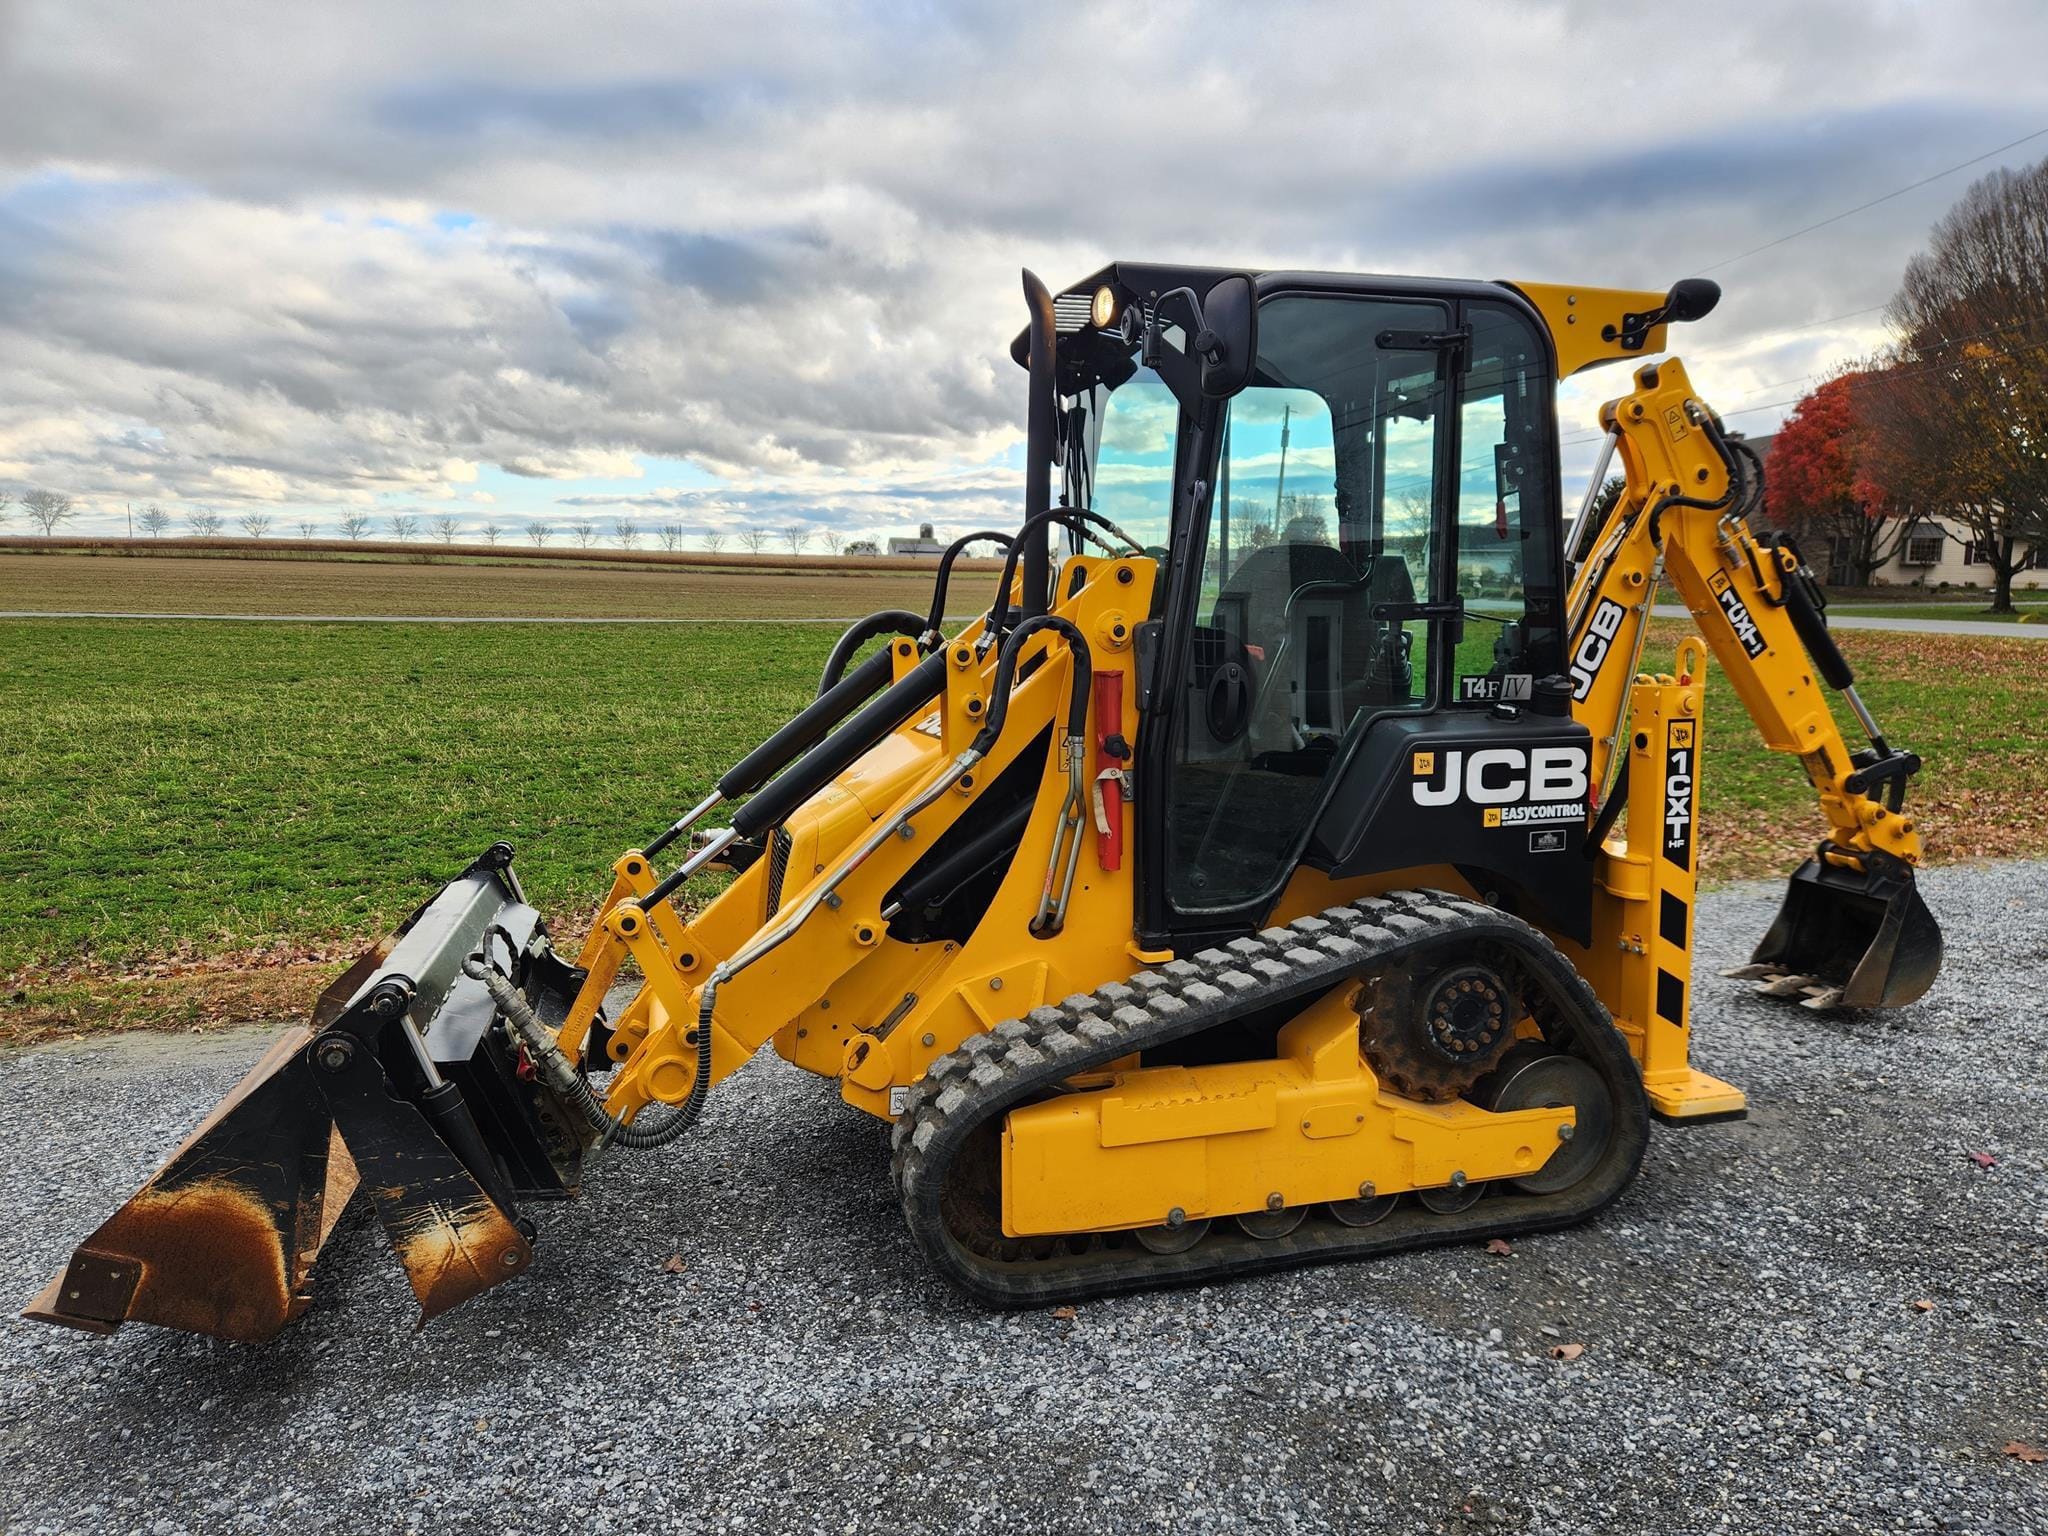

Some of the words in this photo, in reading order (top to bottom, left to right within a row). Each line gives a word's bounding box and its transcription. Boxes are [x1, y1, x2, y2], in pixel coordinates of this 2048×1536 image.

[1721, 589, 1757, 646] 1CXT
[1570, 601, 1623, 699] JCB
[1462, 677, 1500, 698] T4F
[1503, 677, 1528, 698] IV
[1412, 747, 1588, 807] JCB
[1666, 751, 1691, 839] 1CXT
[1501, 804, 1585, 826] EASYCONTROL
[1668, 839, 1685, 849] HF
